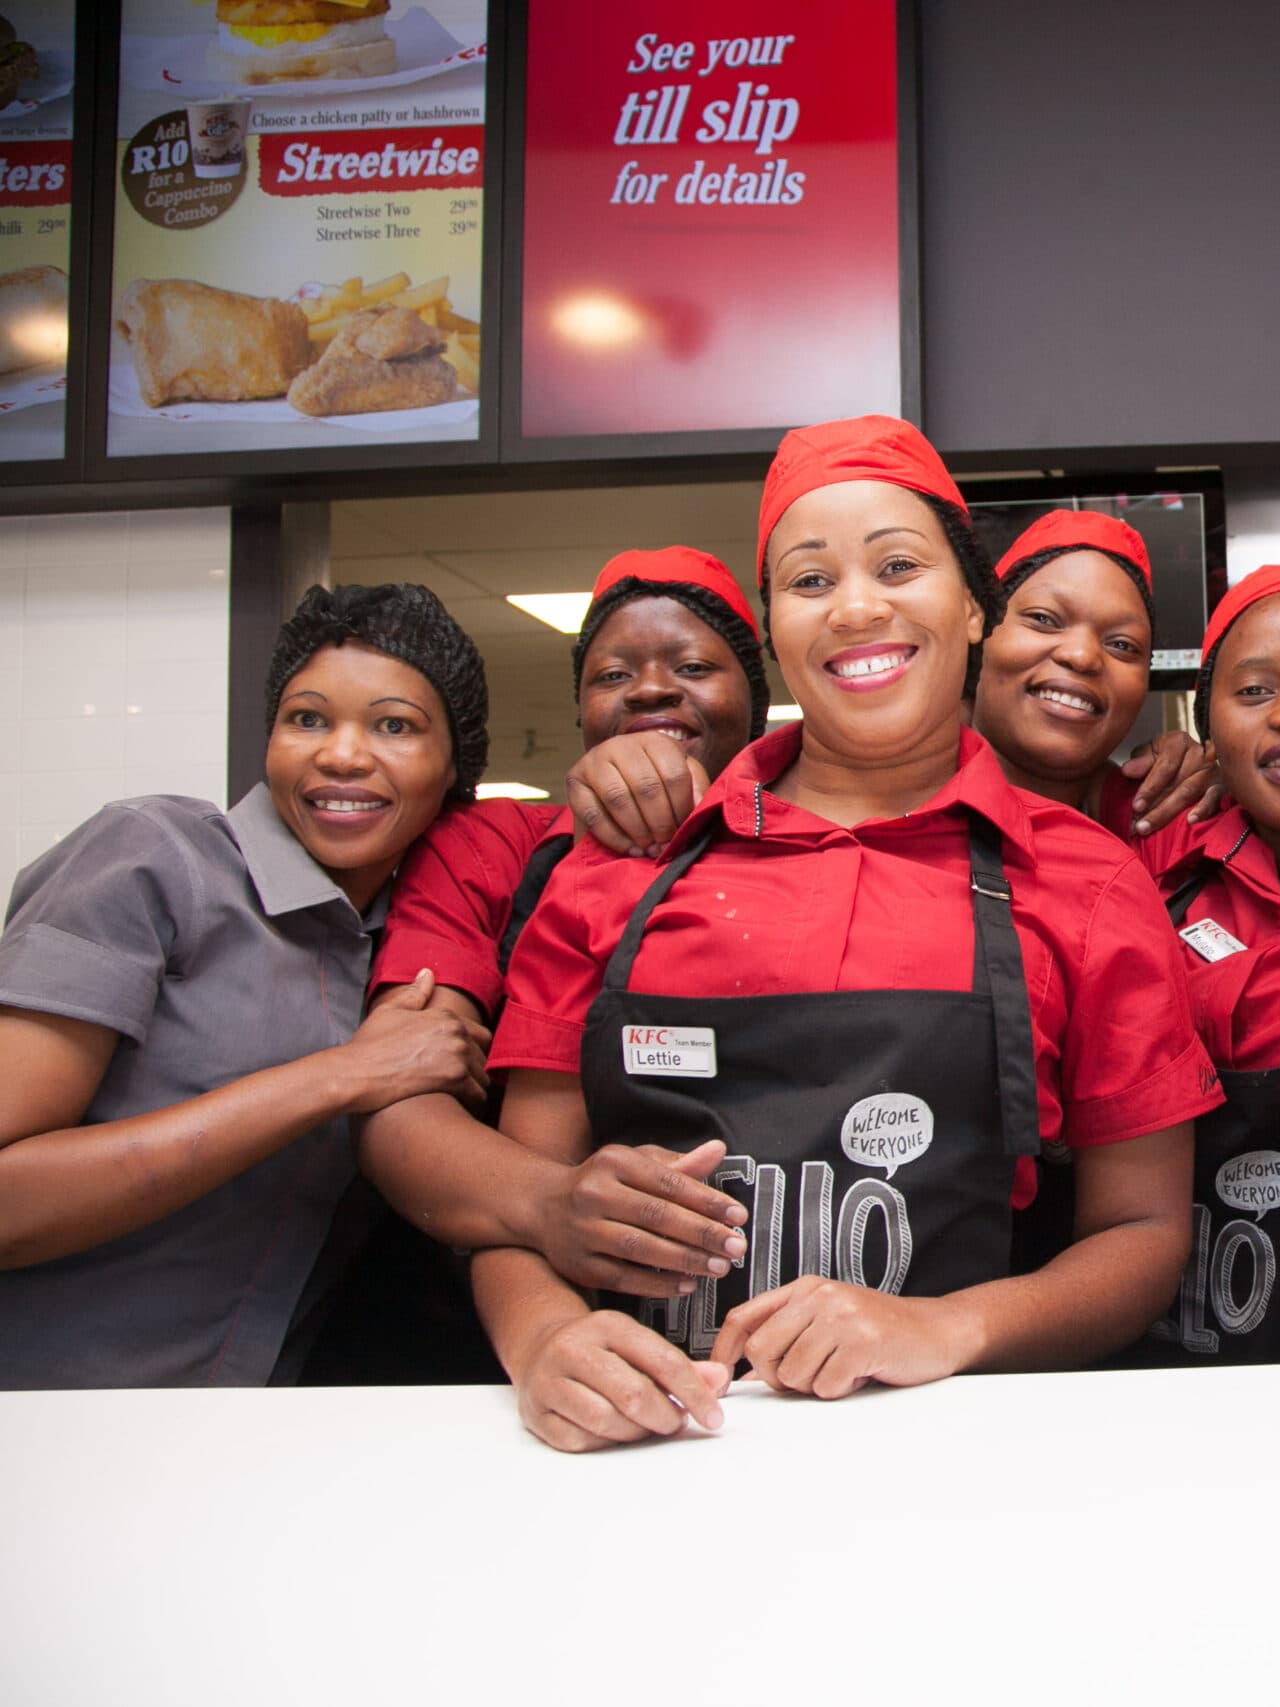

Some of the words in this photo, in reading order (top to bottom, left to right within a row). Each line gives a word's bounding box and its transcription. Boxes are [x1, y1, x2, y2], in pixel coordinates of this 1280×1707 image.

[627, 33, 695, 75] See
[697, 34, 795, 77] your
[252, 112, 296, 128] Choose
[300, 114, 307, 126] a
[310, 109, 358, 126] chicken
[361, 108, 391, 127] patty
[395, 109, 409, 121] or
[413, 104, 480, 121] hashbrown
[613, 84, 692, 145] till
[695, 82, 800, 155] slip
[154, 120, 186, 142] Add
[131, 139, 189, 175] R10
[276, 137, 480, 184] Streetwise
[147, 172, 173, 189] for
[609, 160, 668, 205] for
[674, 159, 806, 206] details
[144, 181, 233, 208] Cappuccino
[164, 202, 218, 225] Combo
[317, 204, 381, 221] Streetwise
[385, 203, 411, 218] Two
[316, 225, 381, 242] Streetwise
[385, 223, 421, 239] Three
[636, 1049, 681, 1066] Lettie
[853, 1107, 920, 1134] WELCOME
[850, 1131, 924, 1160] EVERYONE
